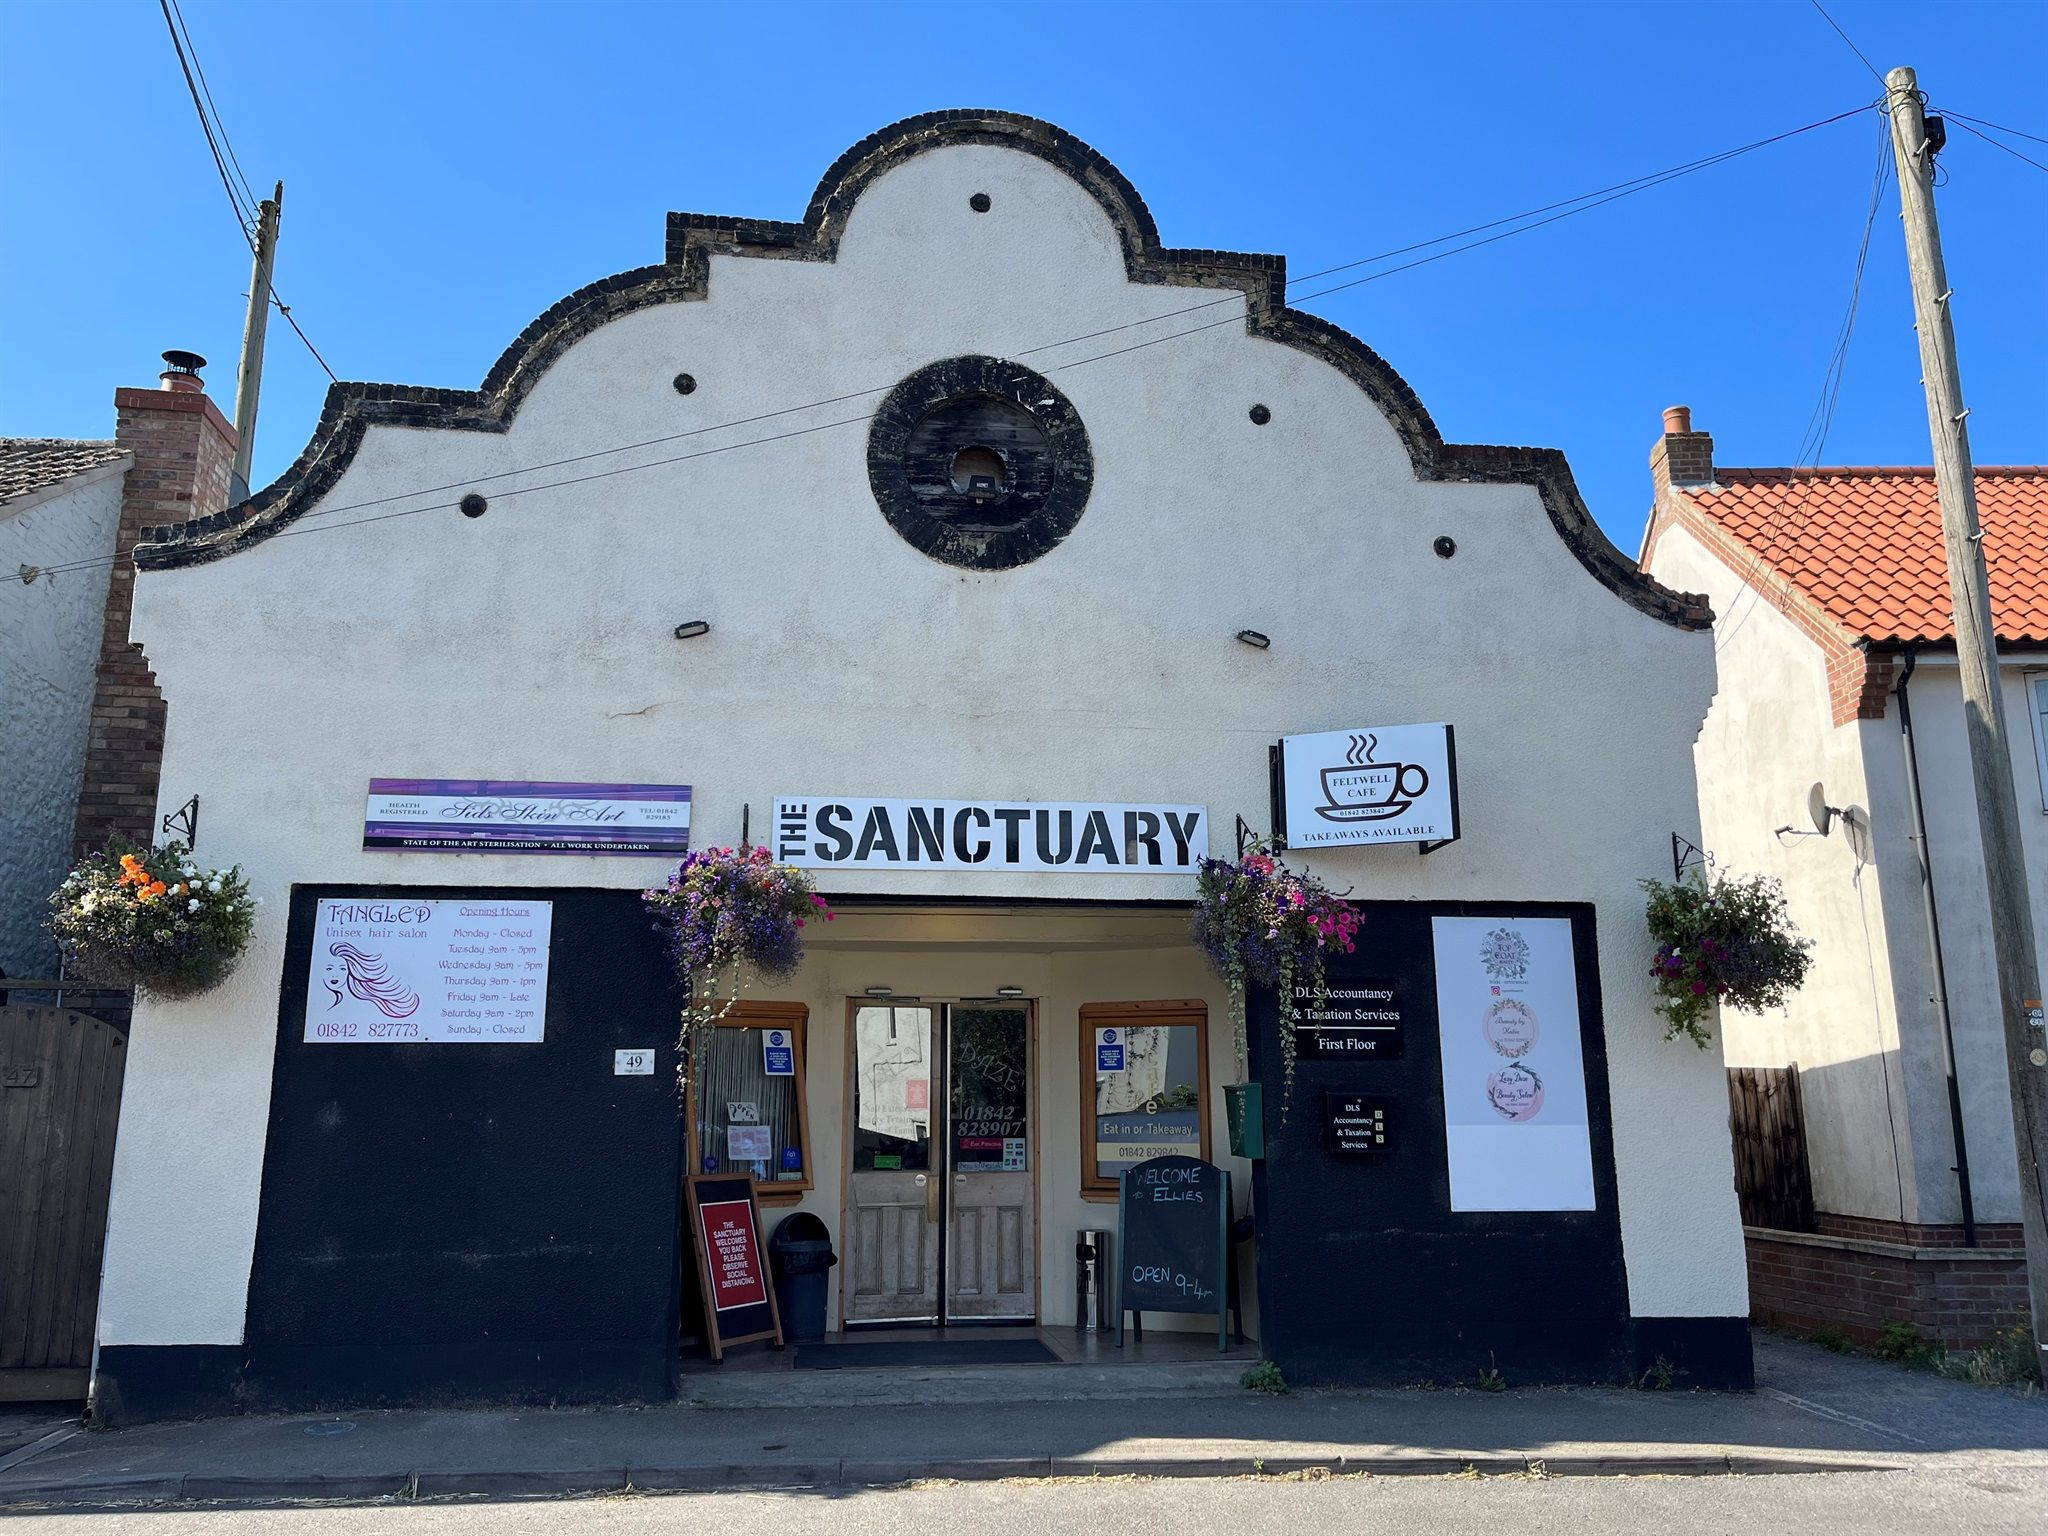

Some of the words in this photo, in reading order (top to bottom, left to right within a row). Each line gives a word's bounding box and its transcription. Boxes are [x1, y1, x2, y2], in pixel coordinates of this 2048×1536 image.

[1332, 774, 1392, 787] FELTWELL
[1347, 788, 1377, 798] CAFE
[501, 802, 558, 821] Skin
[569, 805, 627, 822] Art
[779, 803, 808, 861] THE
[814, 804, 1200, 867] SANCTUARY
[1302, 829, 1369, 842] TAKEAWAYS
[1372, 826, 1436, 838] AVAILABLE
[328, 904, 431, 924] TANGLED
[460, 906, 498, 918] Opening
[500, 907, 530, 917] Hours
[326, 928, 362, 938] Unisex
[368, 928, 394, 938] hair
[398, 928, 428, 938] salon
[453, 929, 491, 940] Monday
[500, 928, 532, 938] Closed
[448, 945, 485, 956] Tuesday
[488, 945, 508, 954] 9am
[438, 960, 492, 972] Wednesday
[494, 961, 514, 970] 9am
[444, 976, 487, 988] Thursday
[490, 977, 509, 985] 9am
[447, 992, 477, 1003] Friday
[480, 993, 500, 1001] 9am
[510, 993, 530, 1002] Late
[1295, 987, 1322, 998] DLS
[1324, 988, 1394, 1002] Accountancy
[440, 1008, 482, 1019] Saturday
[484, 1009, 504, 1018] 9am
[515, 1009, 534, 1019] 2pm
[1292, 1008, 1302, 1019] &
[1304, 1008, 1352, 1020] Taxation
[1354, 1008, 1400, 1020] Services
[317, 1024, 358, 1037] 01842
[368, 1023, 418, 1037] 827773
[446, 1025, 482, 1036] Sunday
[492, 1025, 526, 1034] Closed
[1318, 1038, 1344, 1050] First
[1346, 1038, 1376, 1050] Floor
[626, 1056, 643, 1068] 49
[6, 1068, 34, 1084] 47
[964, 1106, 1015, 1120] 01842
[1333, 1117, 1374, 1126] Accountancy
[958, 1121, 1022, 1136] 828907
[1104, 1124, 1119, 1134] Eat
[1122, 1124, 1130, 1134] in
[1133, 1126, 1144, 1134] or
[1147, 1124, 1193, 1136] Takeaway
[1119, 1147, 1144, 1157] 01842
[1134, 1167, 1202, 1185] WELCOME
[1154, 1187, 1204, 1203] ELLIES
[713, 1229, 746, 1238] SANCTUARY
[715, 1236, 747, 1247] WELCOMES
[719, 1246, 731, 1254] YOU
[731, 1245, 747, 1253] BACK
[723, 1253, 745, 1262] PLEASE
[722, 1261, 748, 1271] OBSERVE
[727, 1270, 748, 1279] SOCIAL
[1132, 1266, 1170, 1282] OPEN
[722, 1277, 755, 1288] DISTANCING
